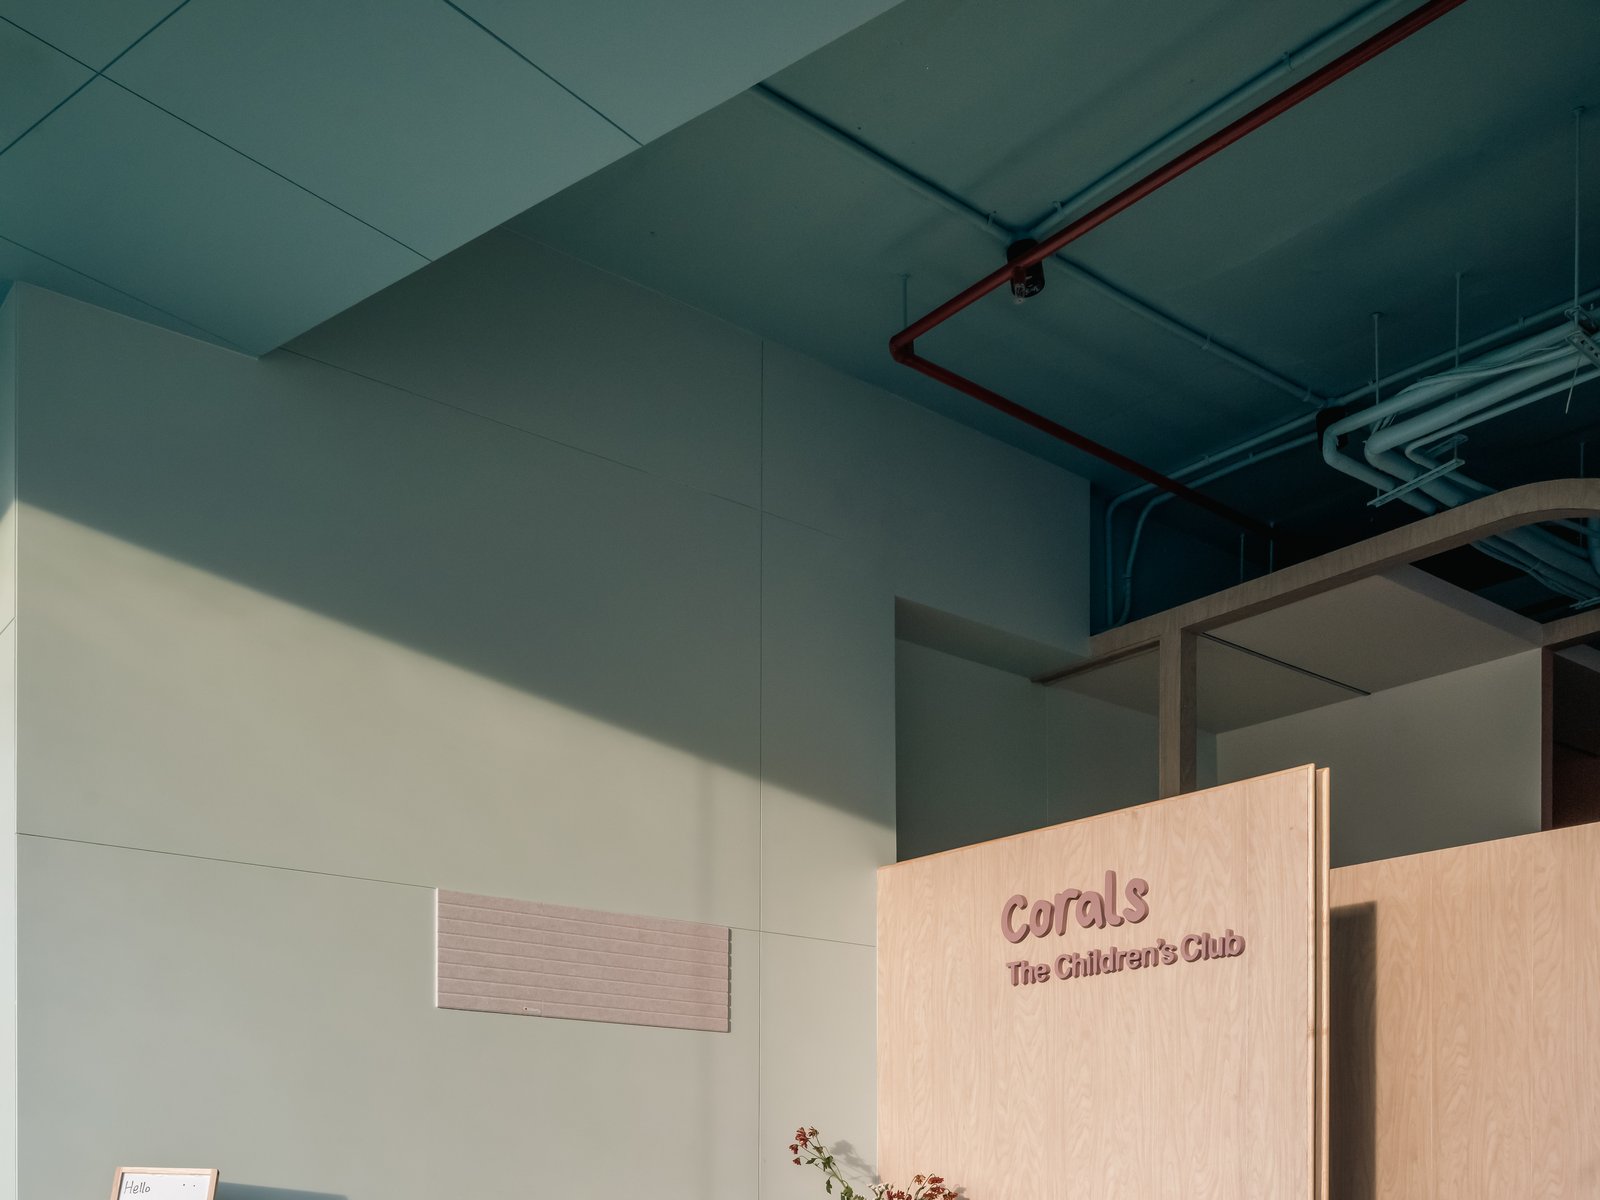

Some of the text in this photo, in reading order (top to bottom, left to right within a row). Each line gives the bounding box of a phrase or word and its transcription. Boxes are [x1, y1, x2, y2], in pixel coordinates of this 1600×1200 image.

[1001, 870, 1150, 944] Corals
[1006, 929, 1246, 987] The Children's Club
[124, 1181, 150, 1193] Hello
